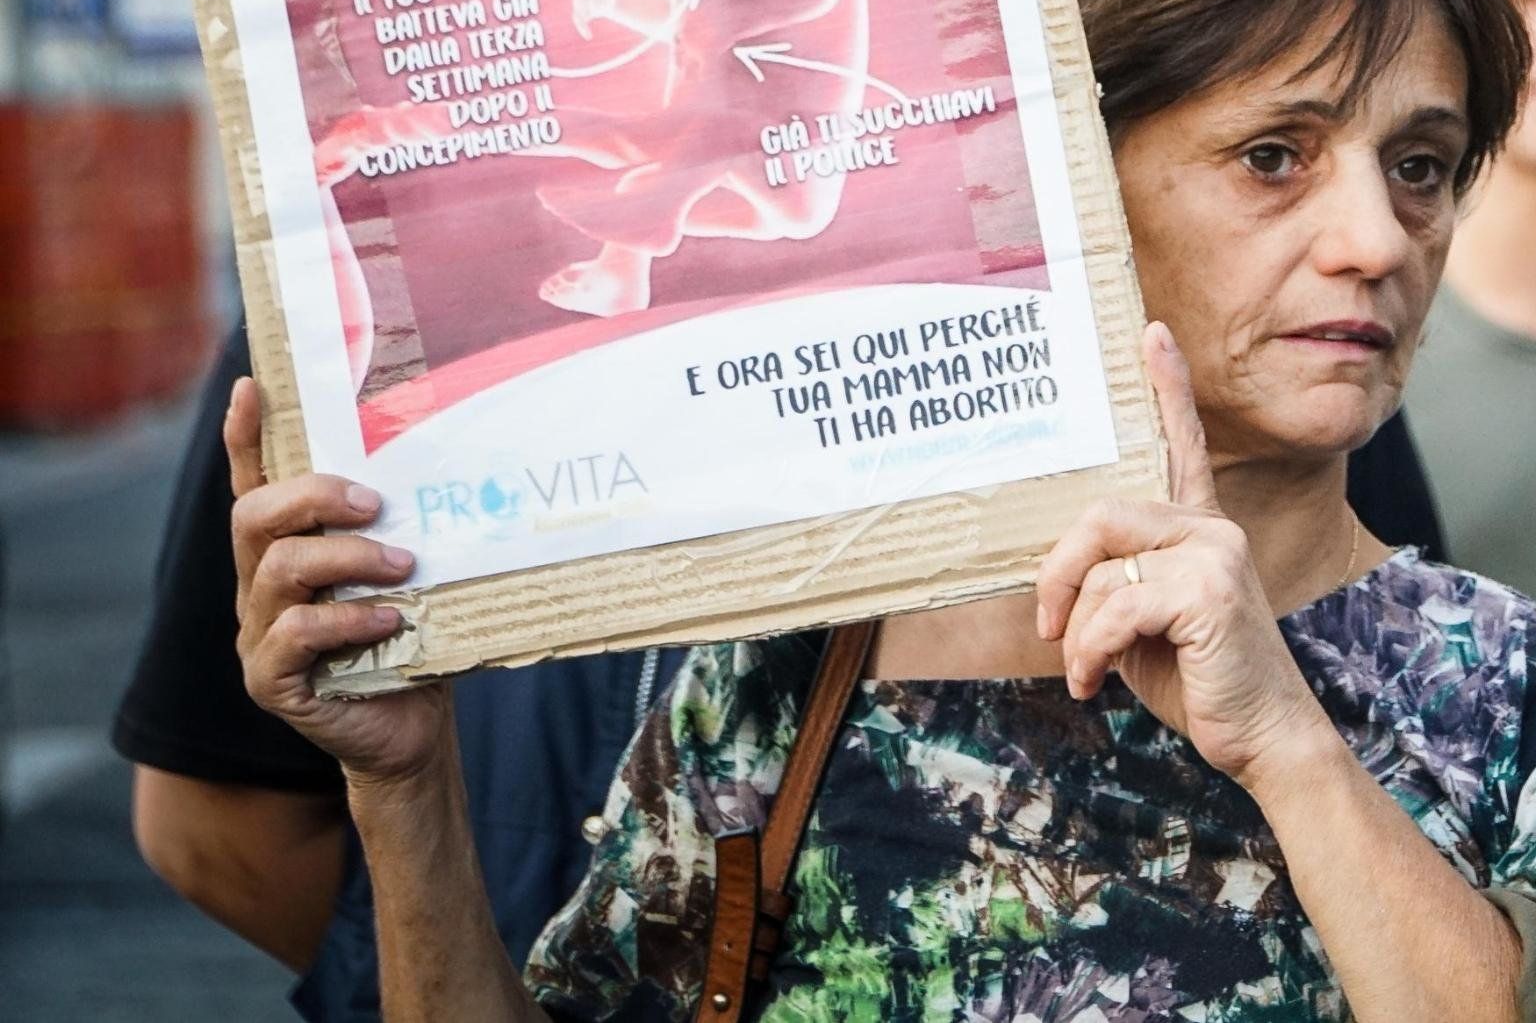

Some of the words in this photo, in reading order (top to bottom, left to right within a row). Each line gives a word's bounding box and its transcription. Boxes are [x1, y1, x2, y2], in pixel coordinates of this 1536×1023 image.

[383, 36, 460, 75] DALLA
[468, 20, 545, 59] TERZA
[407, 51, 551, 104] SETTIMANA
[450, 90, 528, 128] DOPO
[534, 84, 555, 112] IL
[760, 115, 810, 155] GIÀ
[849, 86, 996, 139] SUCCHIAVI
[359, 116, 561, 177] CONCEPIMENTO
[764, 157, 788, 186] IL
[792, 136, 900, 181] POLLICE
[686, 366, 705, 396] E
[717, 352, 783, 390] ORA
[794, 341, 841, 375] SEI
[853, 328, 909, 366] QUI
[920, 296, 1046, 351] PERCHÉ
[772, 381, 831, 418] TUA
[844, 354, 972, 405] MAMMA
[983, 339, 1051, 378] NON
[813, 416, 840, 448] TI
[851, 406, 897, 442] HA
[909, 375, 1059, 431] ABORTITO
